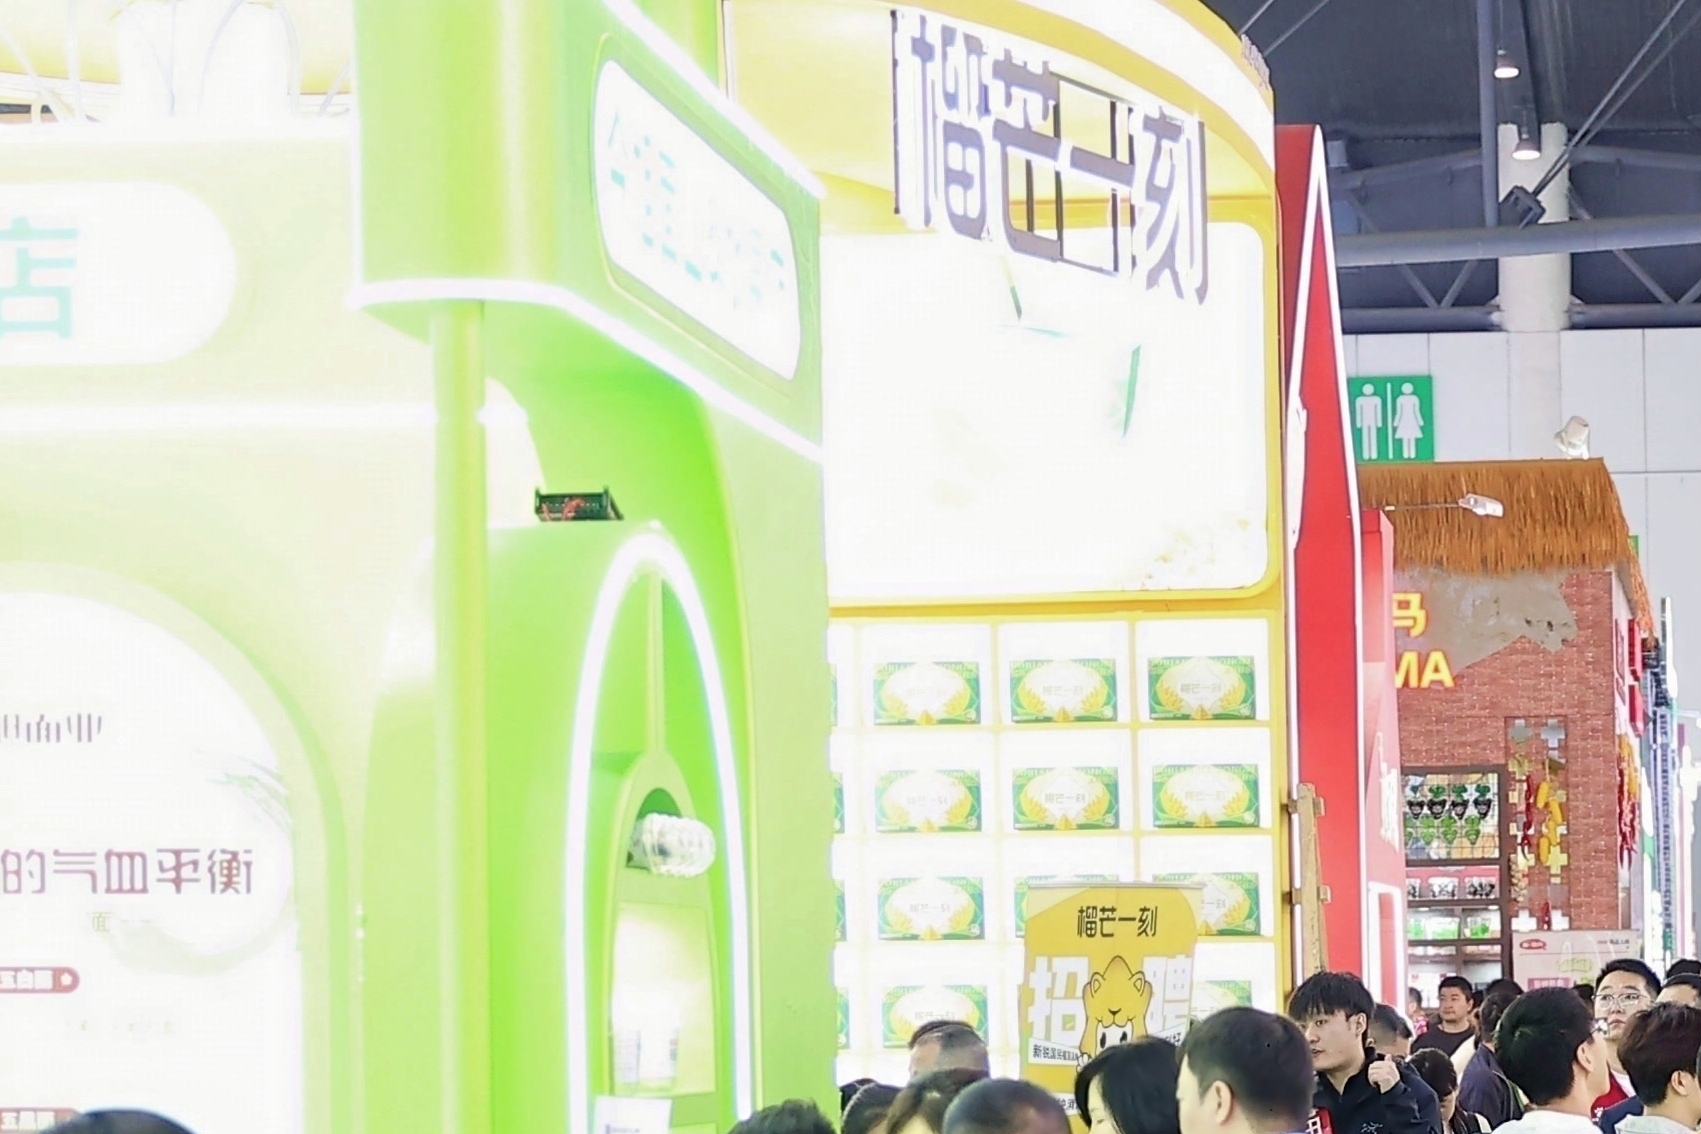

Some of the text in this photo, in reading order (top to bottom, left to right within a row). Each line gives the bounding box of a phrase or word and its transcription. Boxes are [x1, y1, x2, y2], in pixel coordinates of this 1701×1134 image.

[891, 10, 1209, 304] 榴芒一刻
[1, 847, 254, 895] 的气血平衡
[1077, 905, 1158, 939] 榴芒一刻
